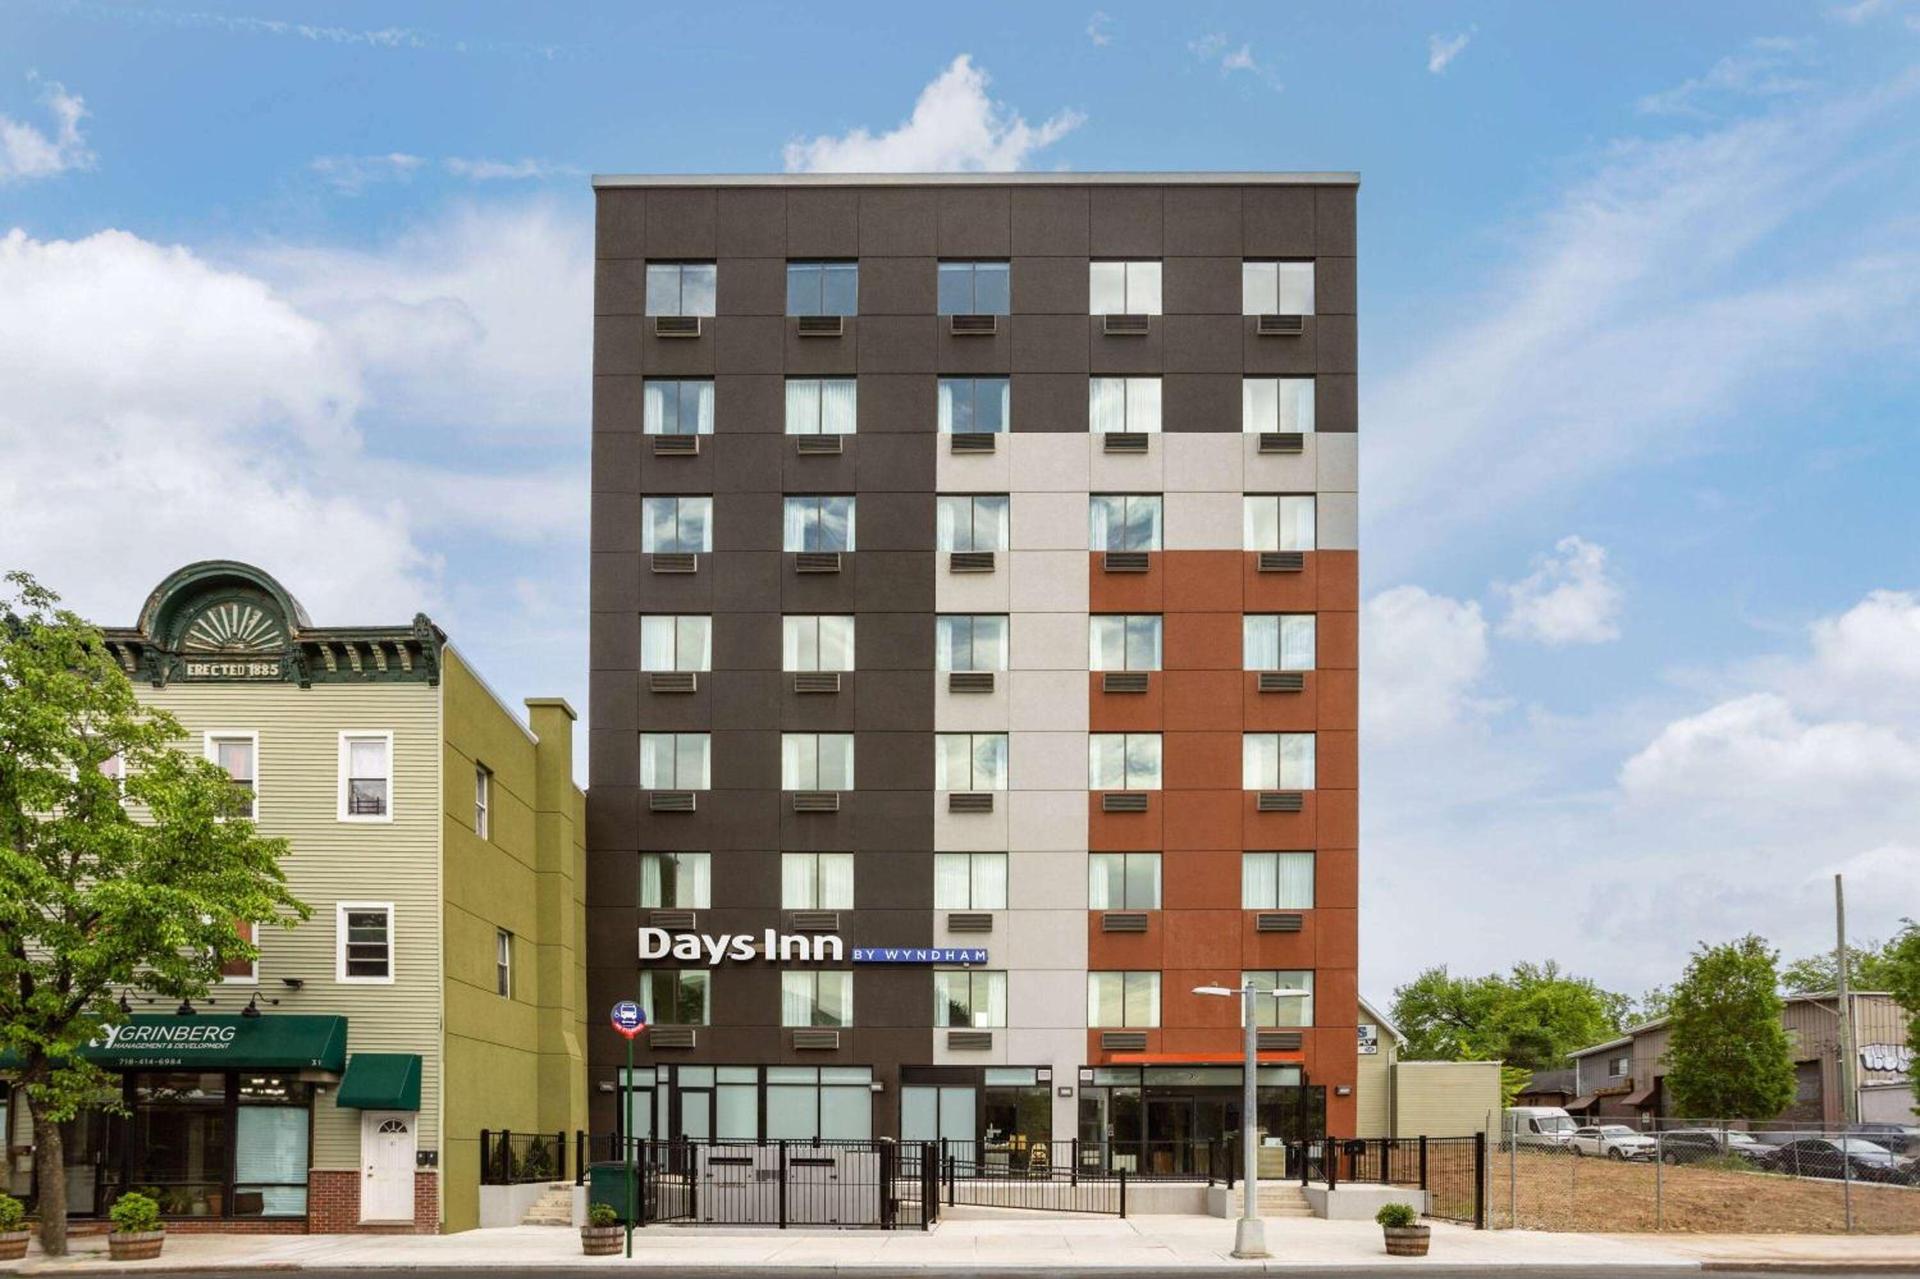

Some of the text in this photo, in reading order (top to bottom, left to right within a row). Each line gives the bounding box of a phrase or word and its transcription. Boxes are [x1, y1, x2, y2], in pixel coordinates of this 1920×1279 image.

[187, 663, 279, 676] ERECTED 1885
[638, 927, 843, 965] Days Inn
[854, 949, 986, 962] BY WYNDHAM
[118, 1025, 237, 1042] GRINBERG
